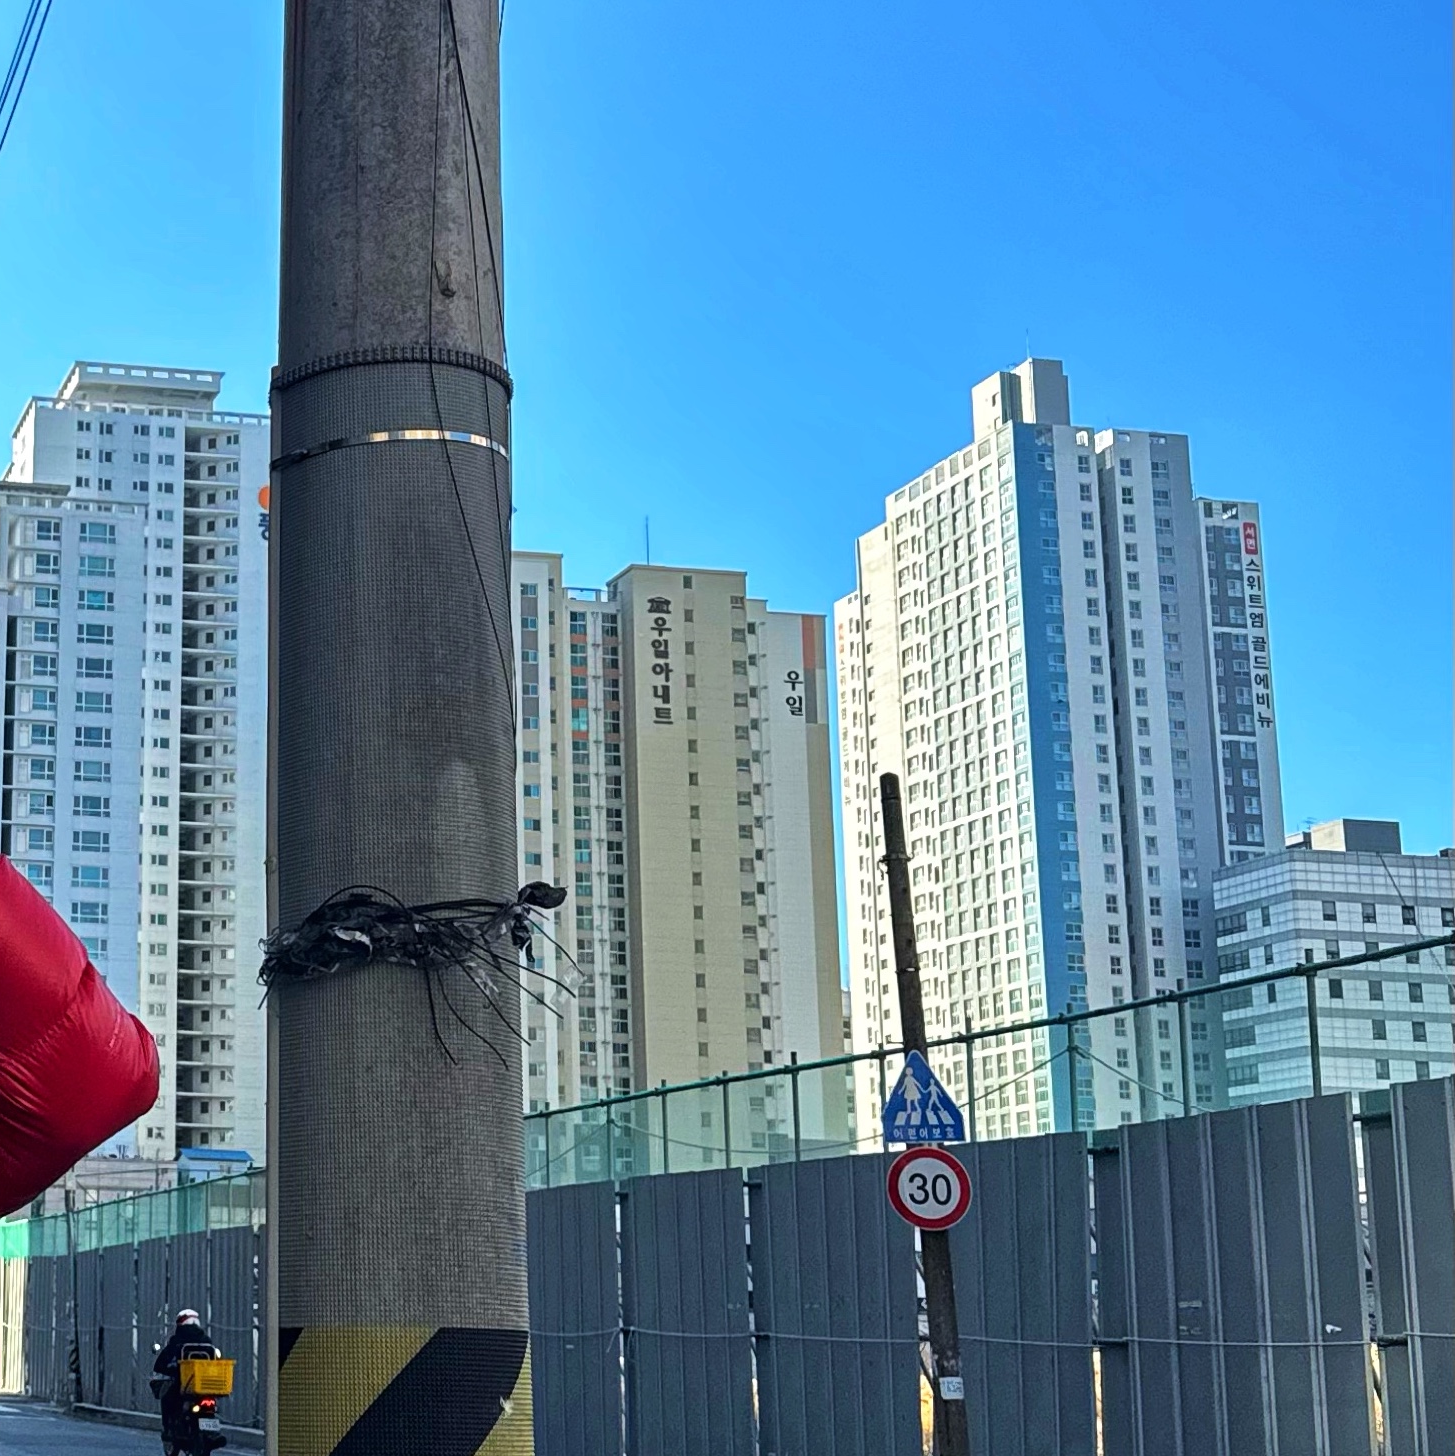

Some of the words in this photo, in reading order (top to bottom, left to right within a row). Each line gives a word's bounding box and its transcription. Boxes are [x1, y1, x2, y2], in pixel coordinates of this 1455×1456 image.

[1246, 525, 1256, 549] 서면
[1245, 558, 1264, 628] 스위트엠
[783, 670, 804, 717] 우일
[1251, 635, 1273, 729] 골드에비뉴
[908, 1172, 952, 1206] 30
